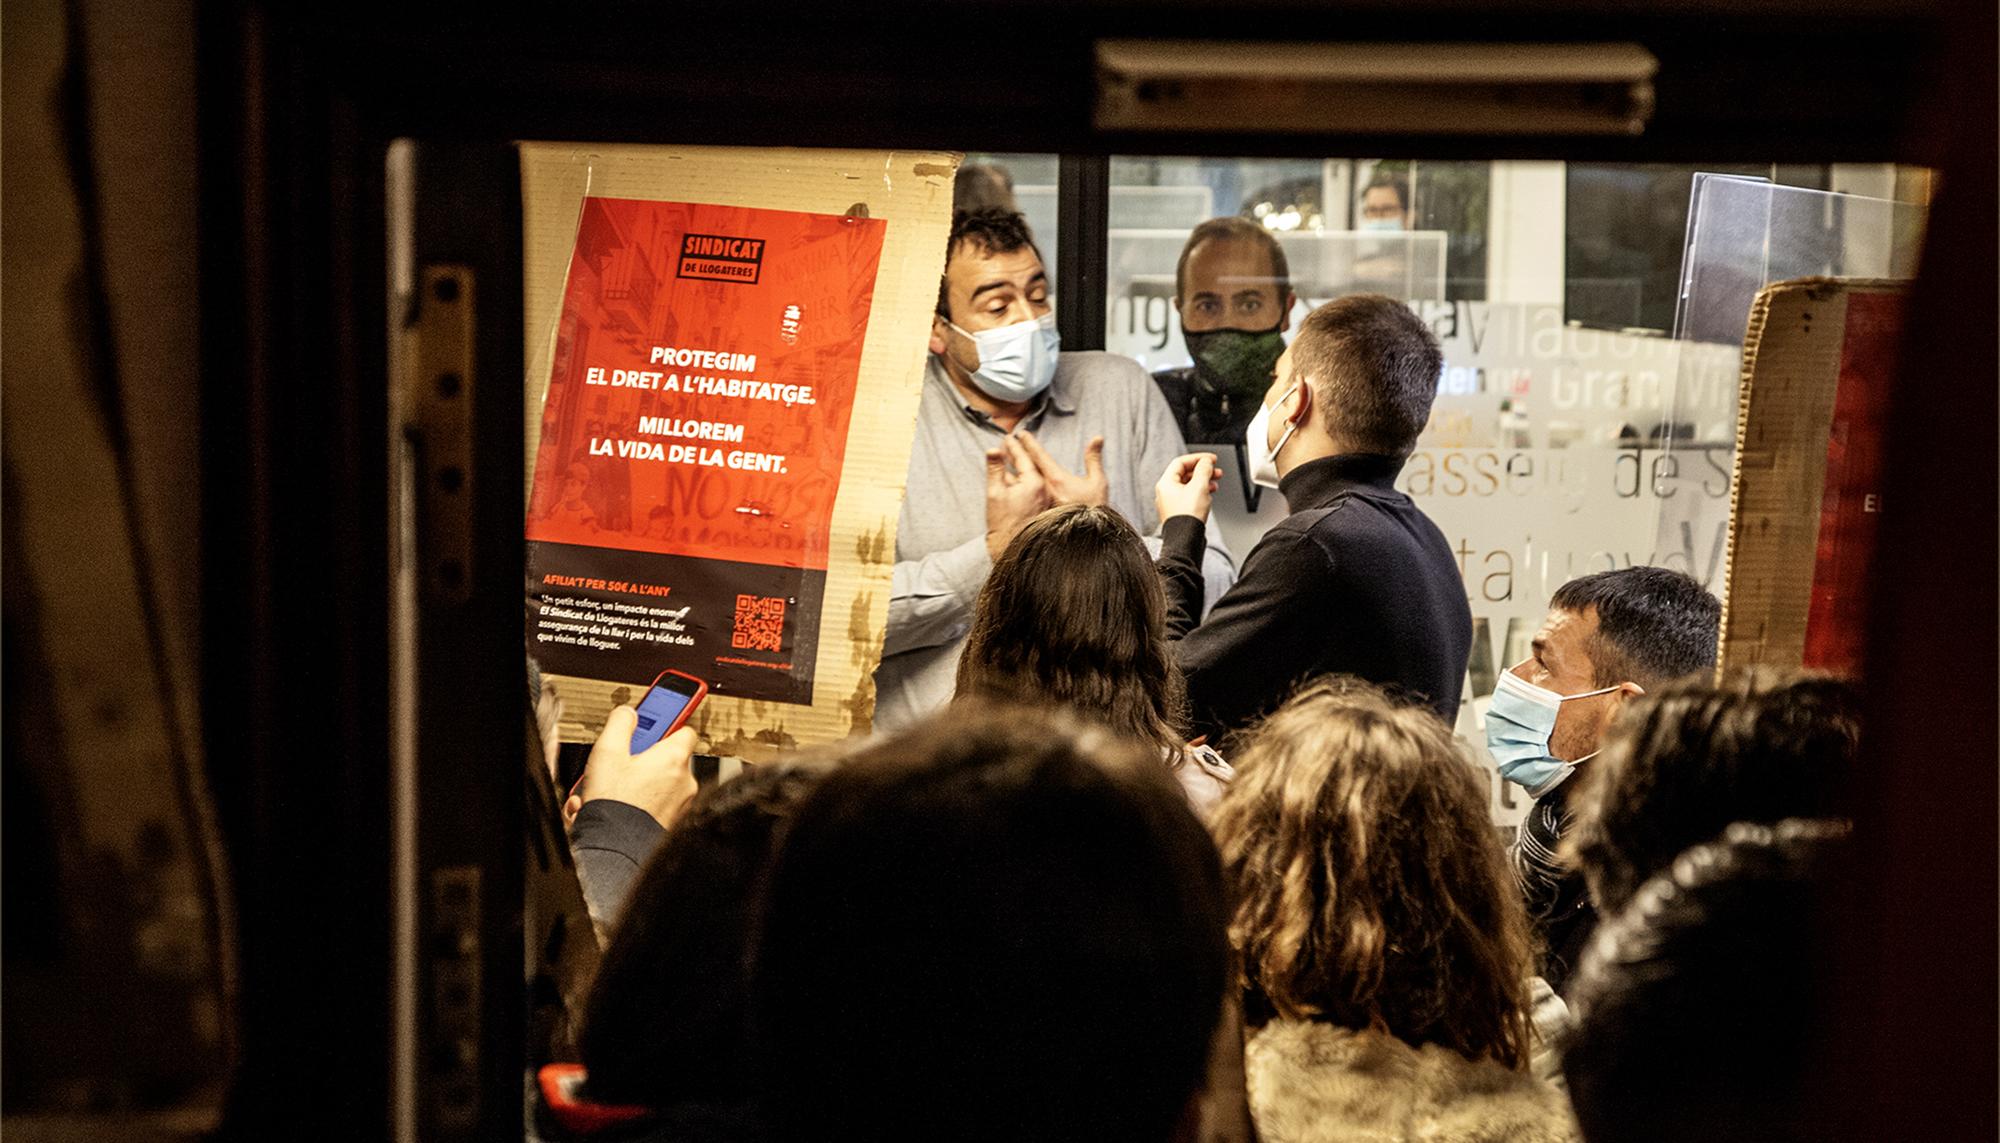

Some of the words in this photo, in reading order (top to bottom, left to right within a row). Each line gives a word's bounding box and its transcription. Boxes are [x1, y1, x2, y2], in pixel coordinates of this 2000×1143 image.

[684, 236, 761, 259] SINDICAT
[685, 262, 697, 274] DE
[698, 263, 754, 277] LLOGATERES
[650, 347, 756, 372] PROTEGIM
[586, 368, 610, 386] EL
[611, 370, 663, 390] DRET
[663, 373, 679, 391] A
[683, 374, 816, 405] L'HABITATGE.
[1551, 364, 1661, 410] Gran
[638, 416, 744, 442] MILLOREM
[589, 438, 614, 456] LA
[618, 439, 665, 461] VIDA
[668, 444, 696, 464] DE
[699, 447, 724, 467] LA
[728, 449, 787, 474] GENT.
[1407, 450, 1588, 514] asseig
[1616, 449, 1679, 498] de
[543, 574, 585, 588] AFILIA'T
[585, 579, 605, 590] PER
[608, 581, 628, 593] 50€
[629, 584, 638, 593] A
[639, 584, 671, 597] L'ANY
[540, 606, 549, 615] El
[549, 607, 583, 620] Sindicat
[584, 611, 595, 620] de
[596, 612, 639, 626] Llogateres
[639, 616, 650, 627] és
[650, 618, 659, 628] la
[659, 620, 686, 631] millor
[554, 596, 574, 607] petit
[602, 602, 613, 610] un
[615, 602, 648, 615] impacte
[649, 608, 680, 618] enorm
[537, 632, 553, 643] que
[554, 633, 575, 644] vivim
[576, 636, 588, 646] de
[589, 637, 621, 651] lloguer.
[538, 620, 588, 634] assegurança
[589, 624, 601, 634] de
[601, 626, 610, 636] la
[611, 627, 624, 638] llar
[630, 630, 646, 641] per
[646, 632, 655, 641] la
[655, 632, 675, 643] vida
[675, 635, 695, 646] dels
